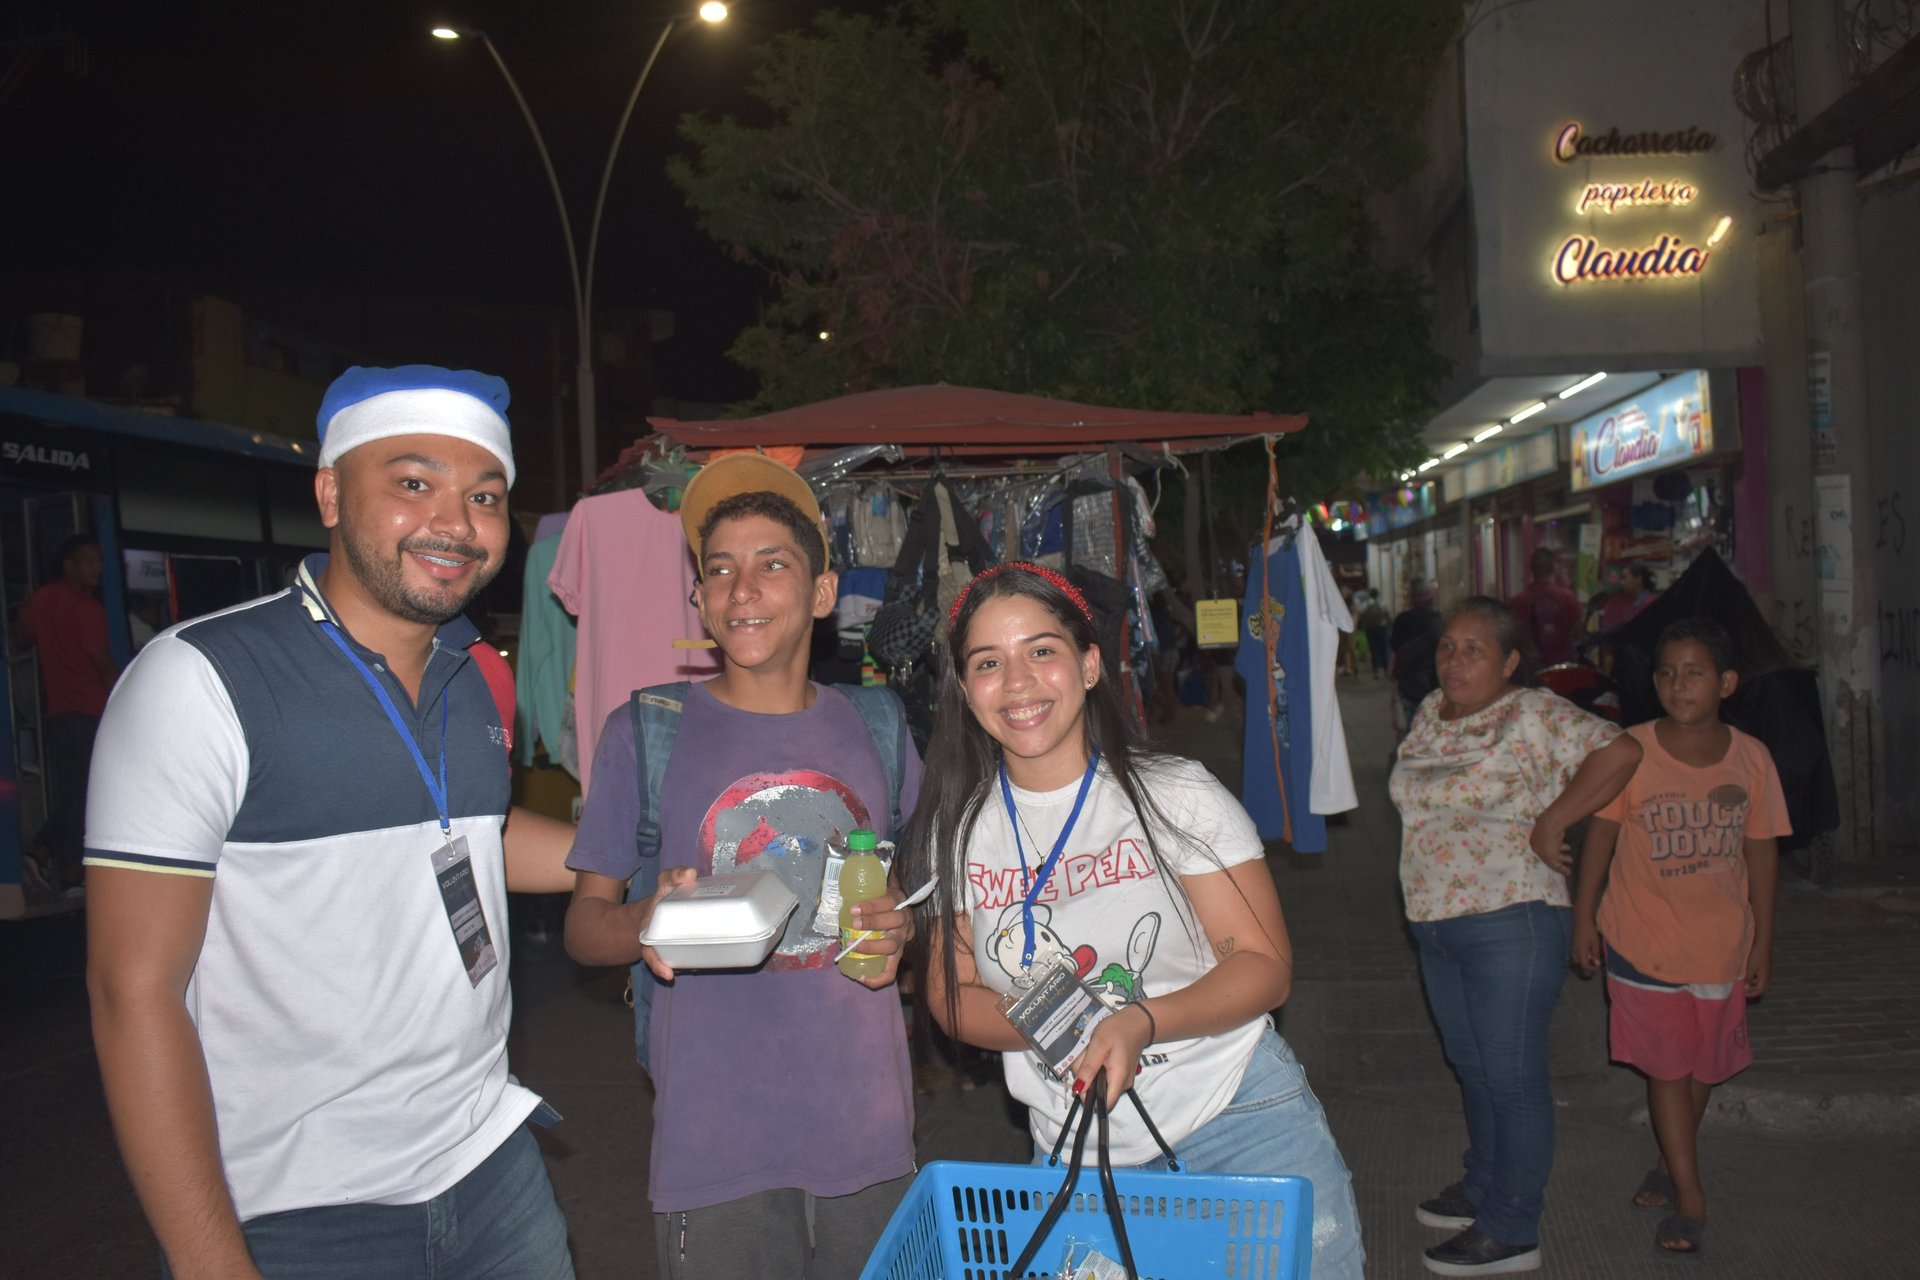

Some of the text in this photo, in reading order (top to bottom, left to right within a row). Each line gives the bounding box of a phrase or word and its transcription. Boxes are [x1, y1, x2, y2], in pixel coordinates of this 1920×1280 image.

[1556, 236, 1709, 284] Claudia
[2, 441, 91, 471] SALIDA
[1594, 416, 1660, 475] Claudia
[1649, 827, 1742, 861] DOWN
[1018, 971, 1066, 1020] VOLUNTARIO
